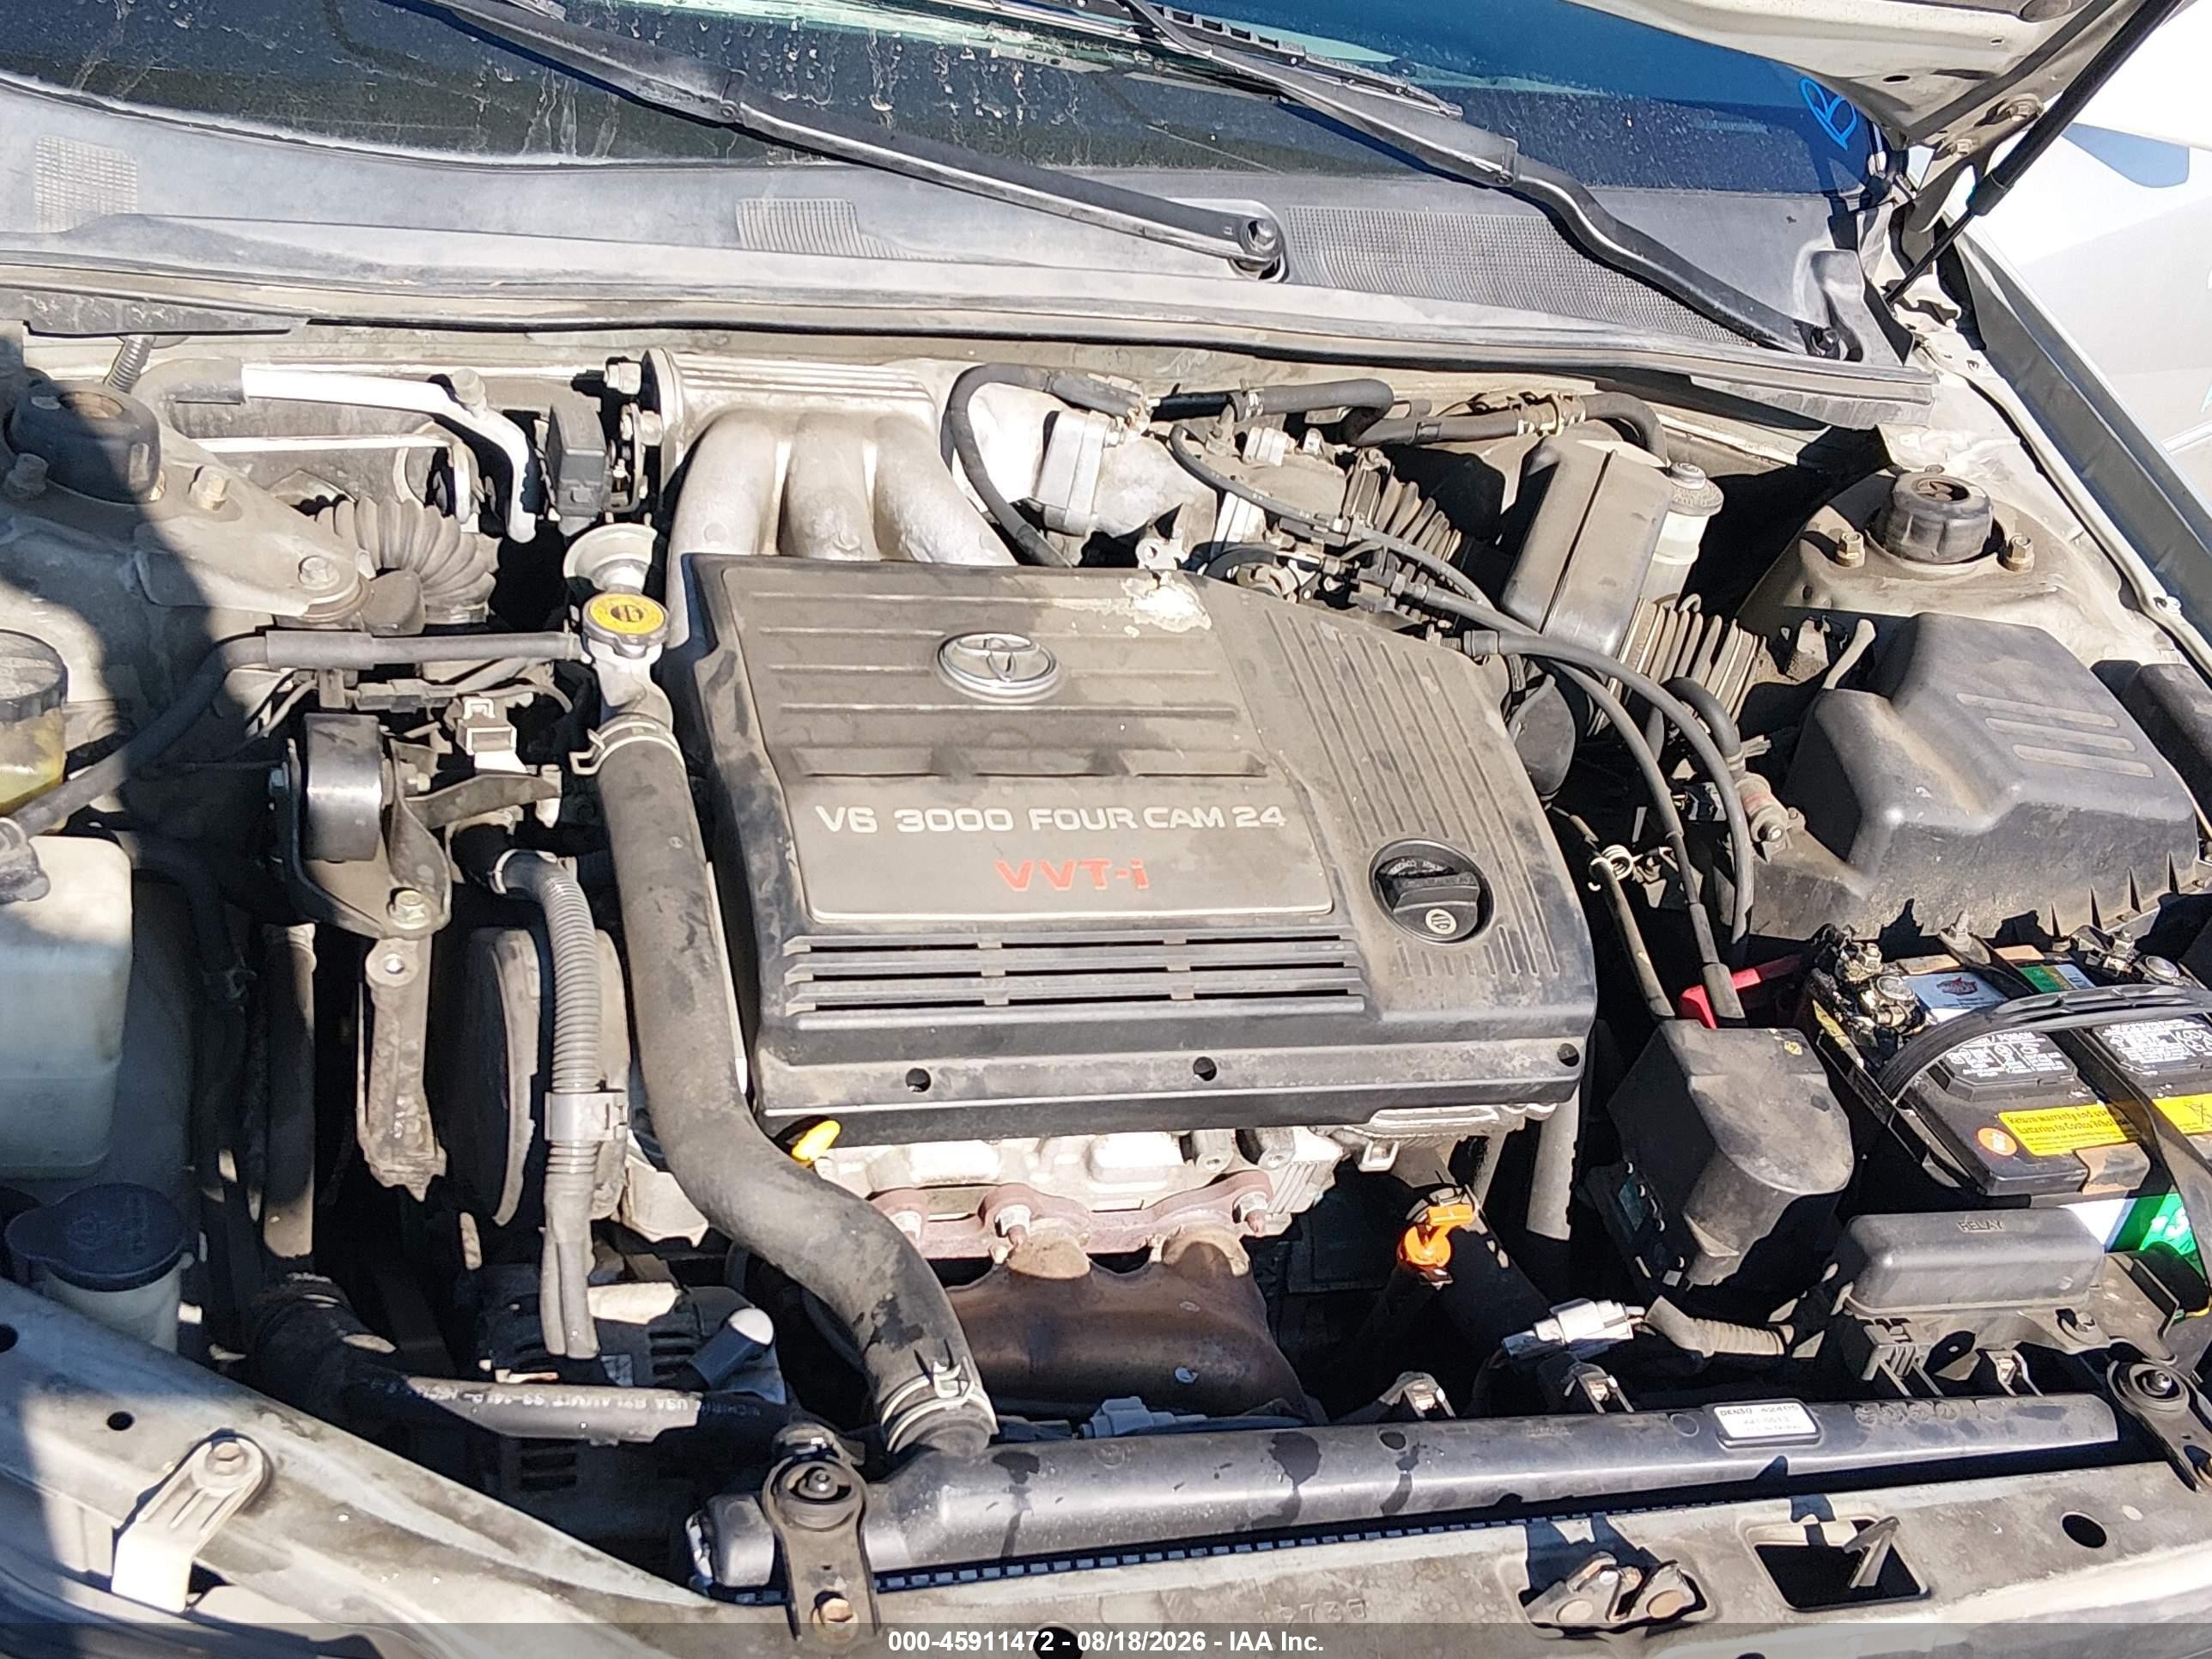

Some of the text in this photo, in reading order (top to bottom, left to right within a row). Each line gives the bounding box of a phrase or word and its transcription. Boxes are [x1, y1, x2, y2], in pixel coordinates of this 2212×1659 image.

[815, 805, 1286, 834] V6 3000 FOUR CAM 24
[995, 859, 1150, 892] VVT-i
[1957, 1219, 2003, 1231] RELAY
[654, 1399, 689, 1411] USA
[1720, 1407, 1753, 1416] DENSO
